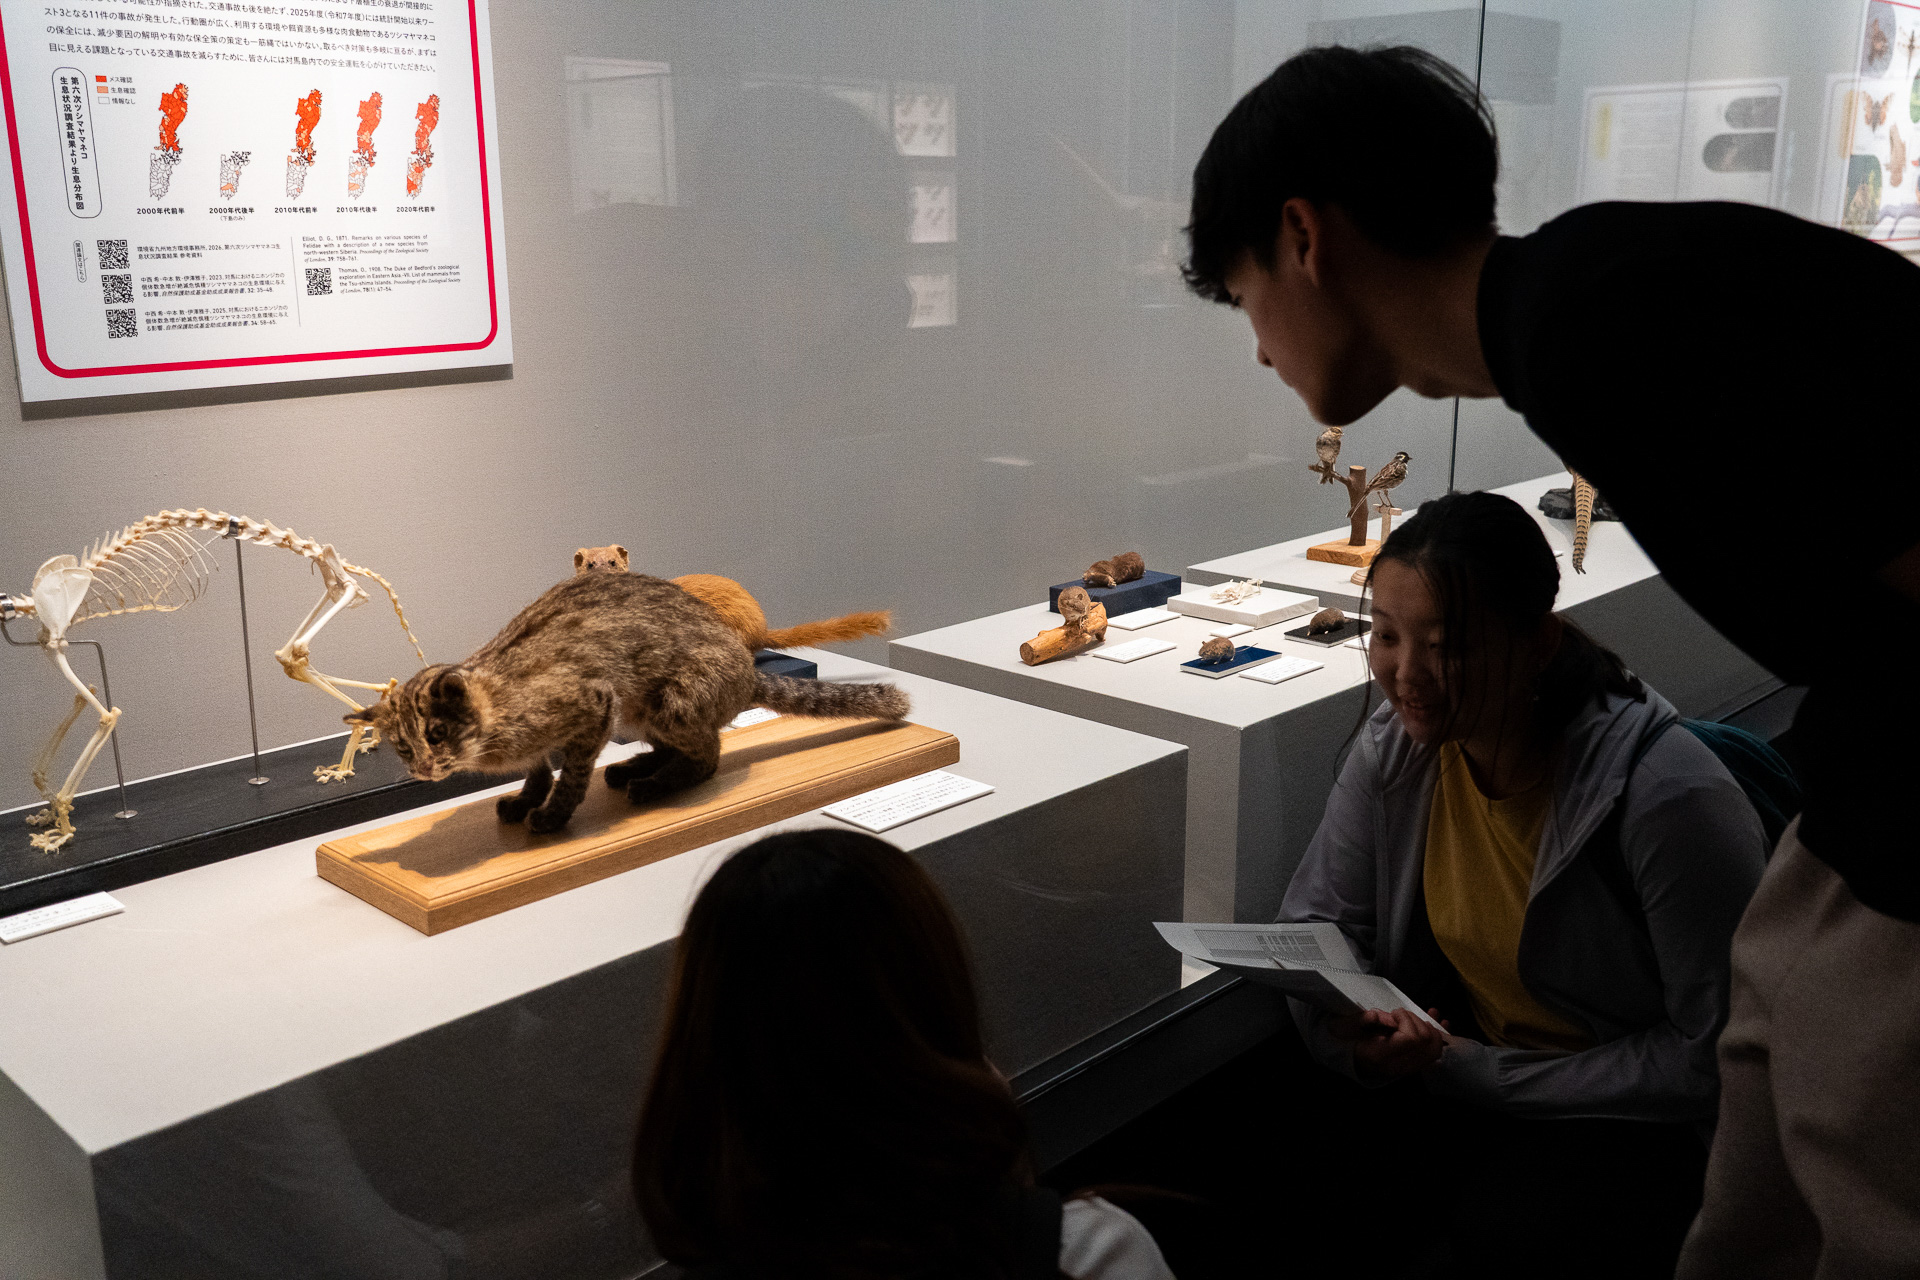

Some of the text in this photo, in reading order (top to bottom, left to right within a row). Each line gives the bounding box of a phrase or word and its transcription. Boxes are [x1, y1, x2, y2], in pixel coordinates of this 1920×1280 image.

[109, 76, 133, 84] メス確認
[111, 97, 136, 105] 情報なし
[70, 76, 88, 159] 第六次ツシマヤマネコ
[60, 76, 84, 210] 生息状況調査結果より生息分布図
[136, 207, 185, 215] 2000年代前半
[274, 206, 318, 214] 2010年代前半
